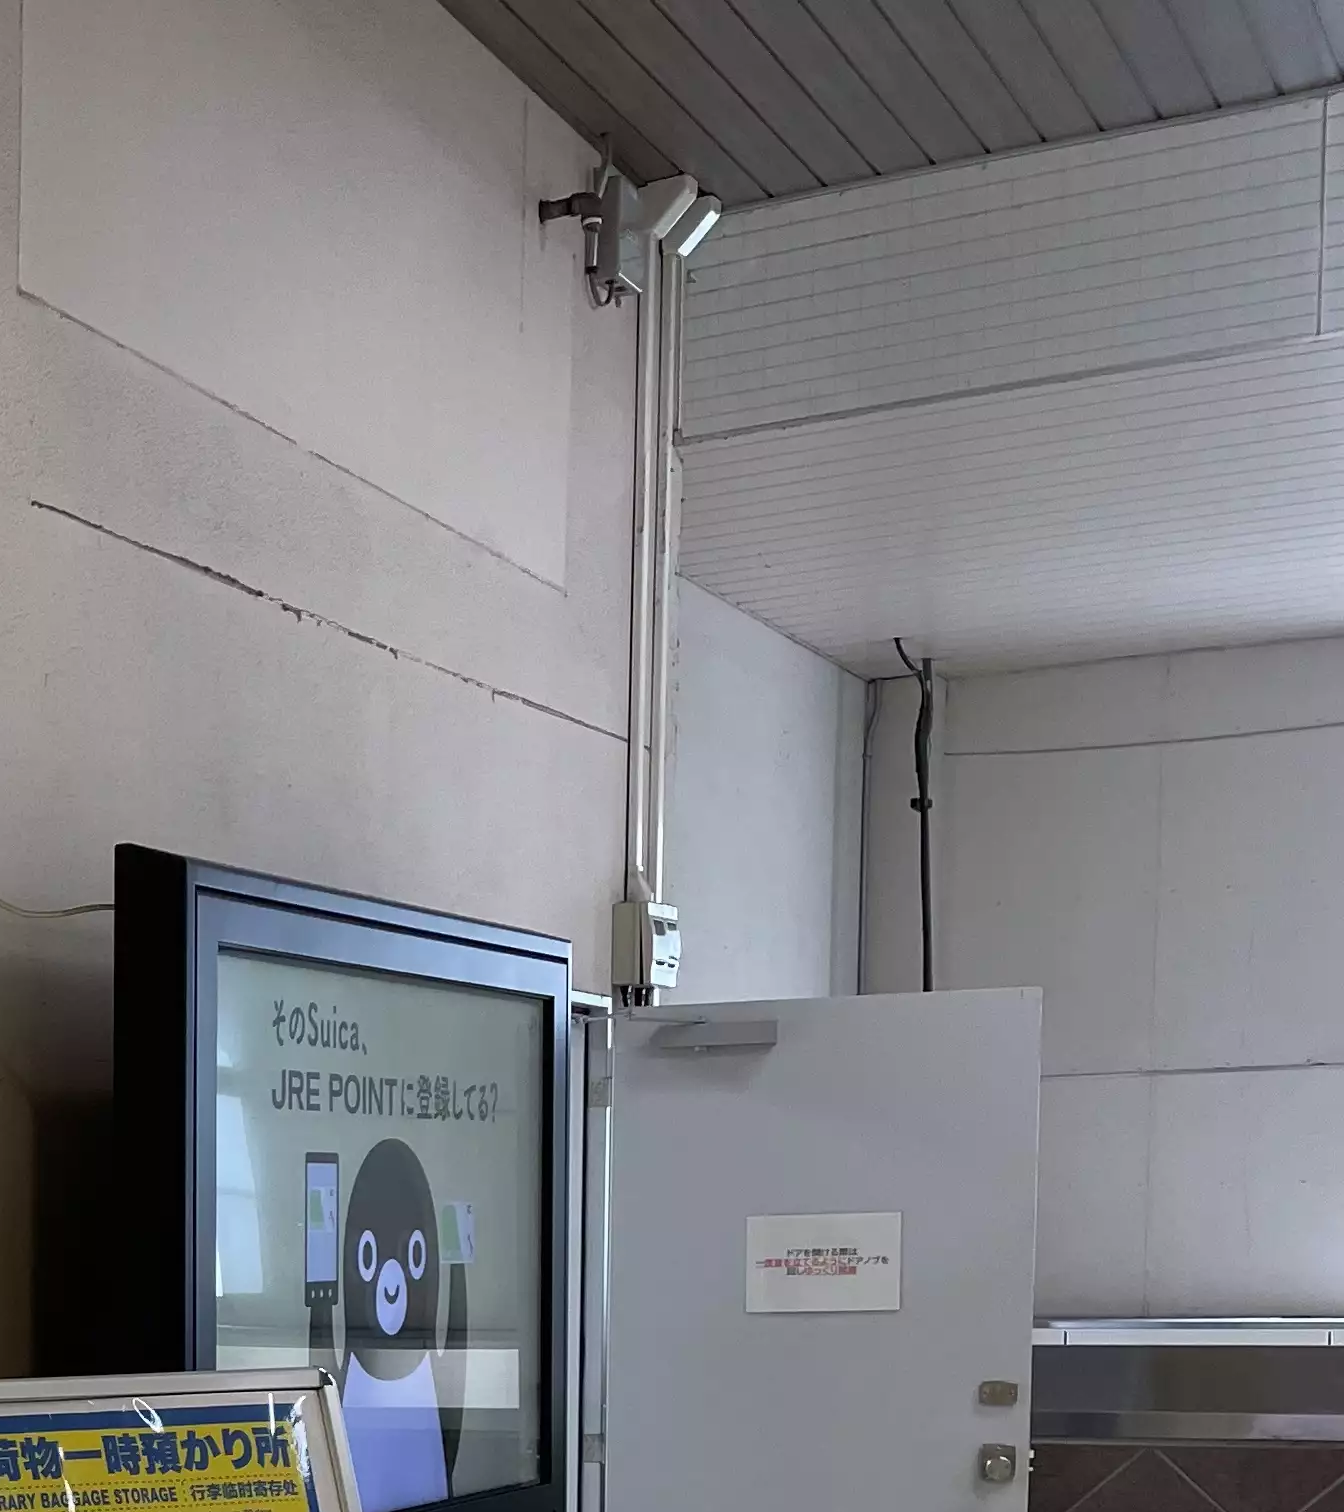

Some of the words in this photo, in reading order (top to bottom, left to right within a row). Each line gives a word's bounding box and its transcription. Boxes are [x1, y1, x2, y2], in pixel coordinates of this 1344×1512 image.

[272, 1000, 367, 1055] そのSuica、
[272, 1069, 320, 1112] JRE
[114, 1487, 177, 1505] STORAGE
[190, 1480, 299, 1501] 行李临时寄存处
